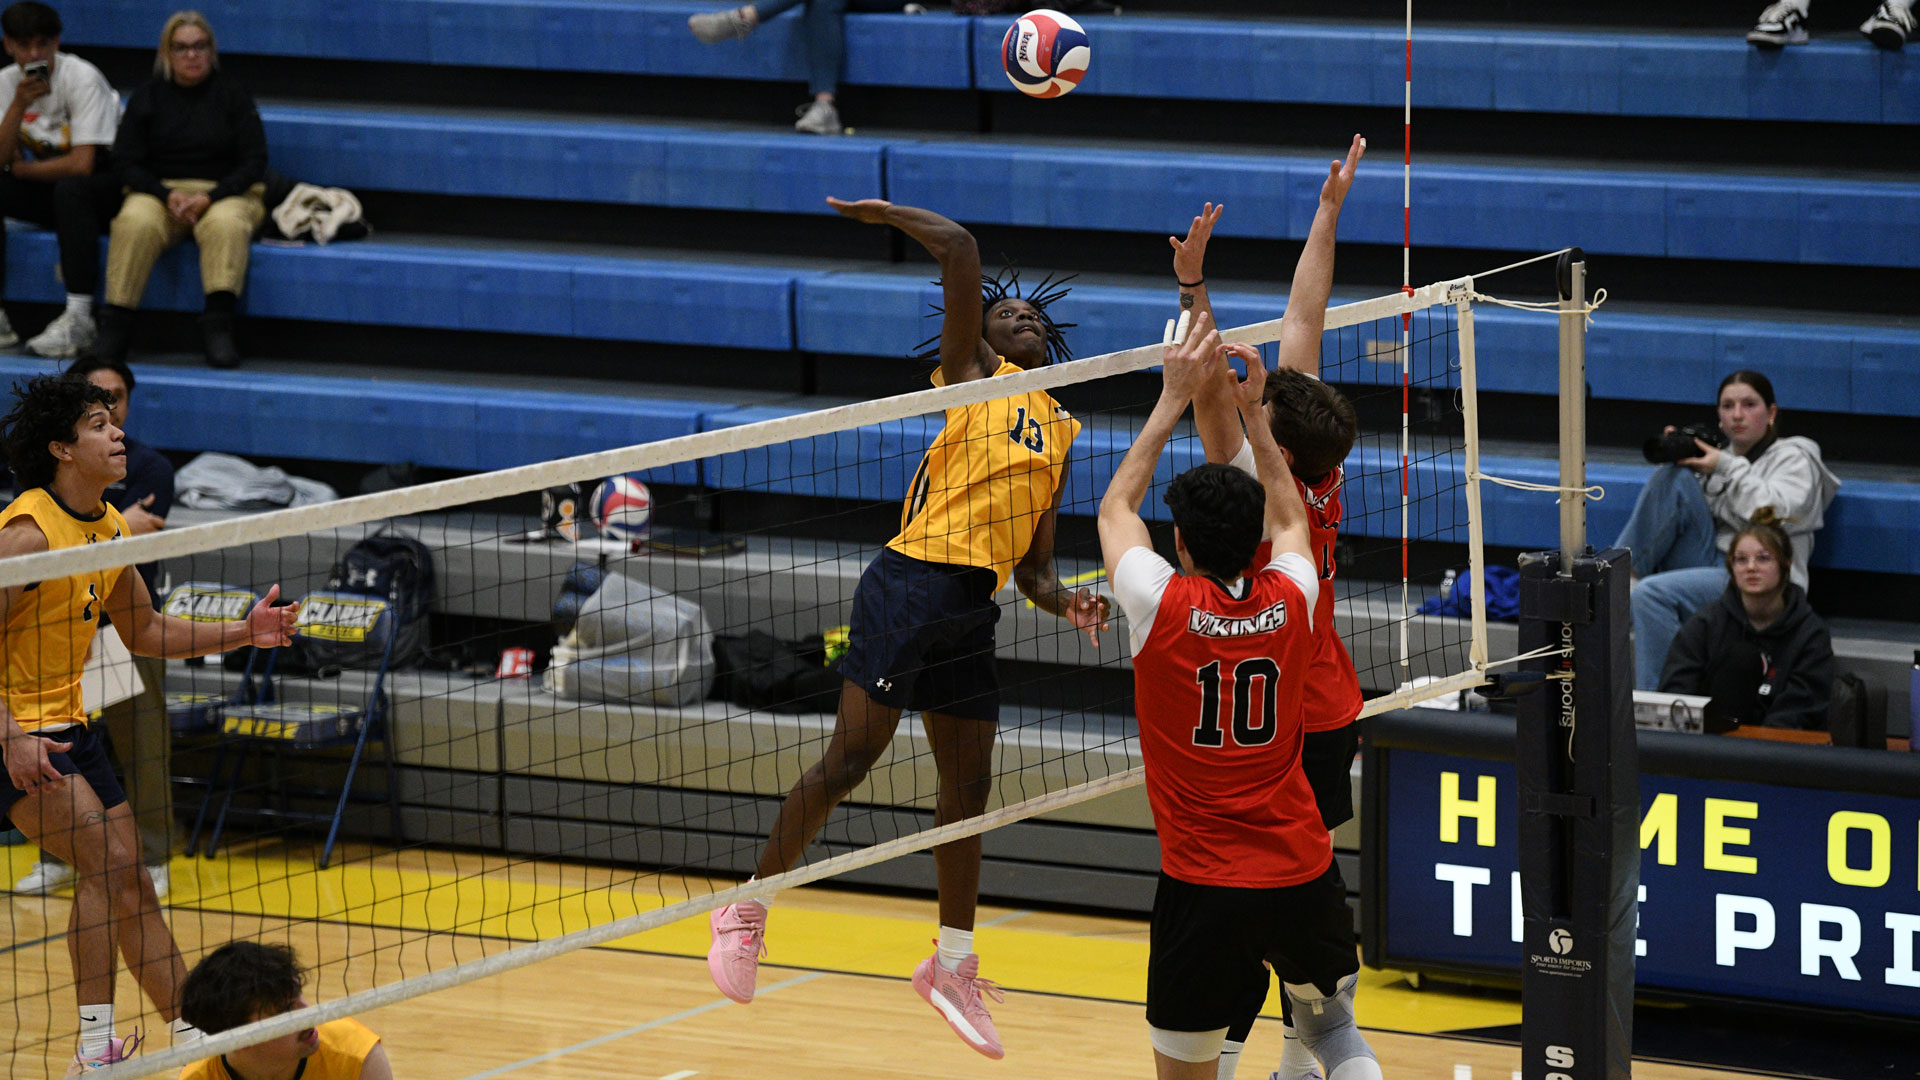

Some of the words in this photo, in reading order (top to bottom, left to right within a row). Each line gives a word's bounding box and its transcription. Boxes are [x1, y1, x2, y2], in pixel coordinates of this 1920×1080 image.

[1019, 32, 1033, 62] NAIA
[1009, 407, 1044, 454] 13
[1188, 600, 1287, 638] VIKINGS
[1192, 657, 1280, 748] 10
[1439, 772, 1758, 874] HME
[1531, 954, 1558, 964] SPORTS
[1559, 958, 1591, 970] IMPORTS
